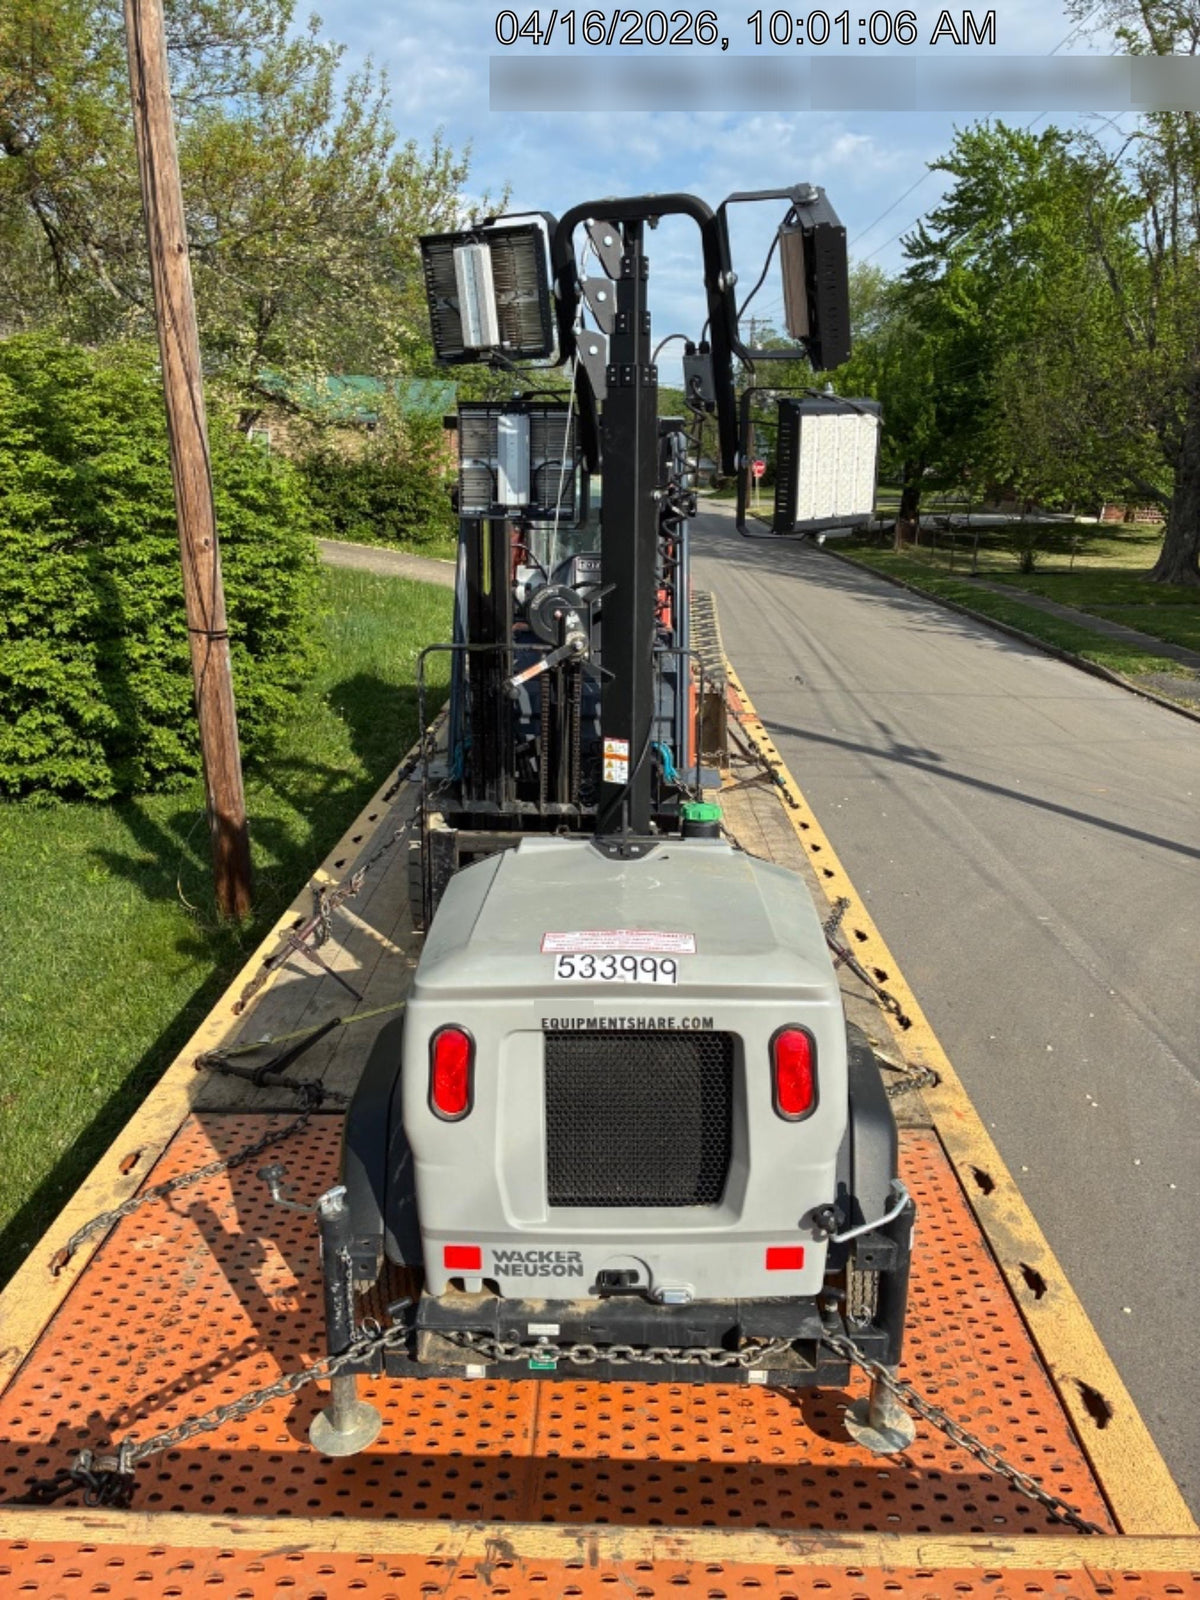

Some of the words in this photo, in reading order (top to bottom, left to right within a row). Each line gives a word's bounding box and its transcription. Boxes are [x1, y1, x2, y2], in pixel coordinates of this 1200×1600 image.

[557, 953, 677, 984] 533999
[541, 1017, 715, 1030] EQUIPMENTSHARE.COM
[492, 1250, 582, 1263] WACKER
[493, 1264, 584, 1277] NEUSON
